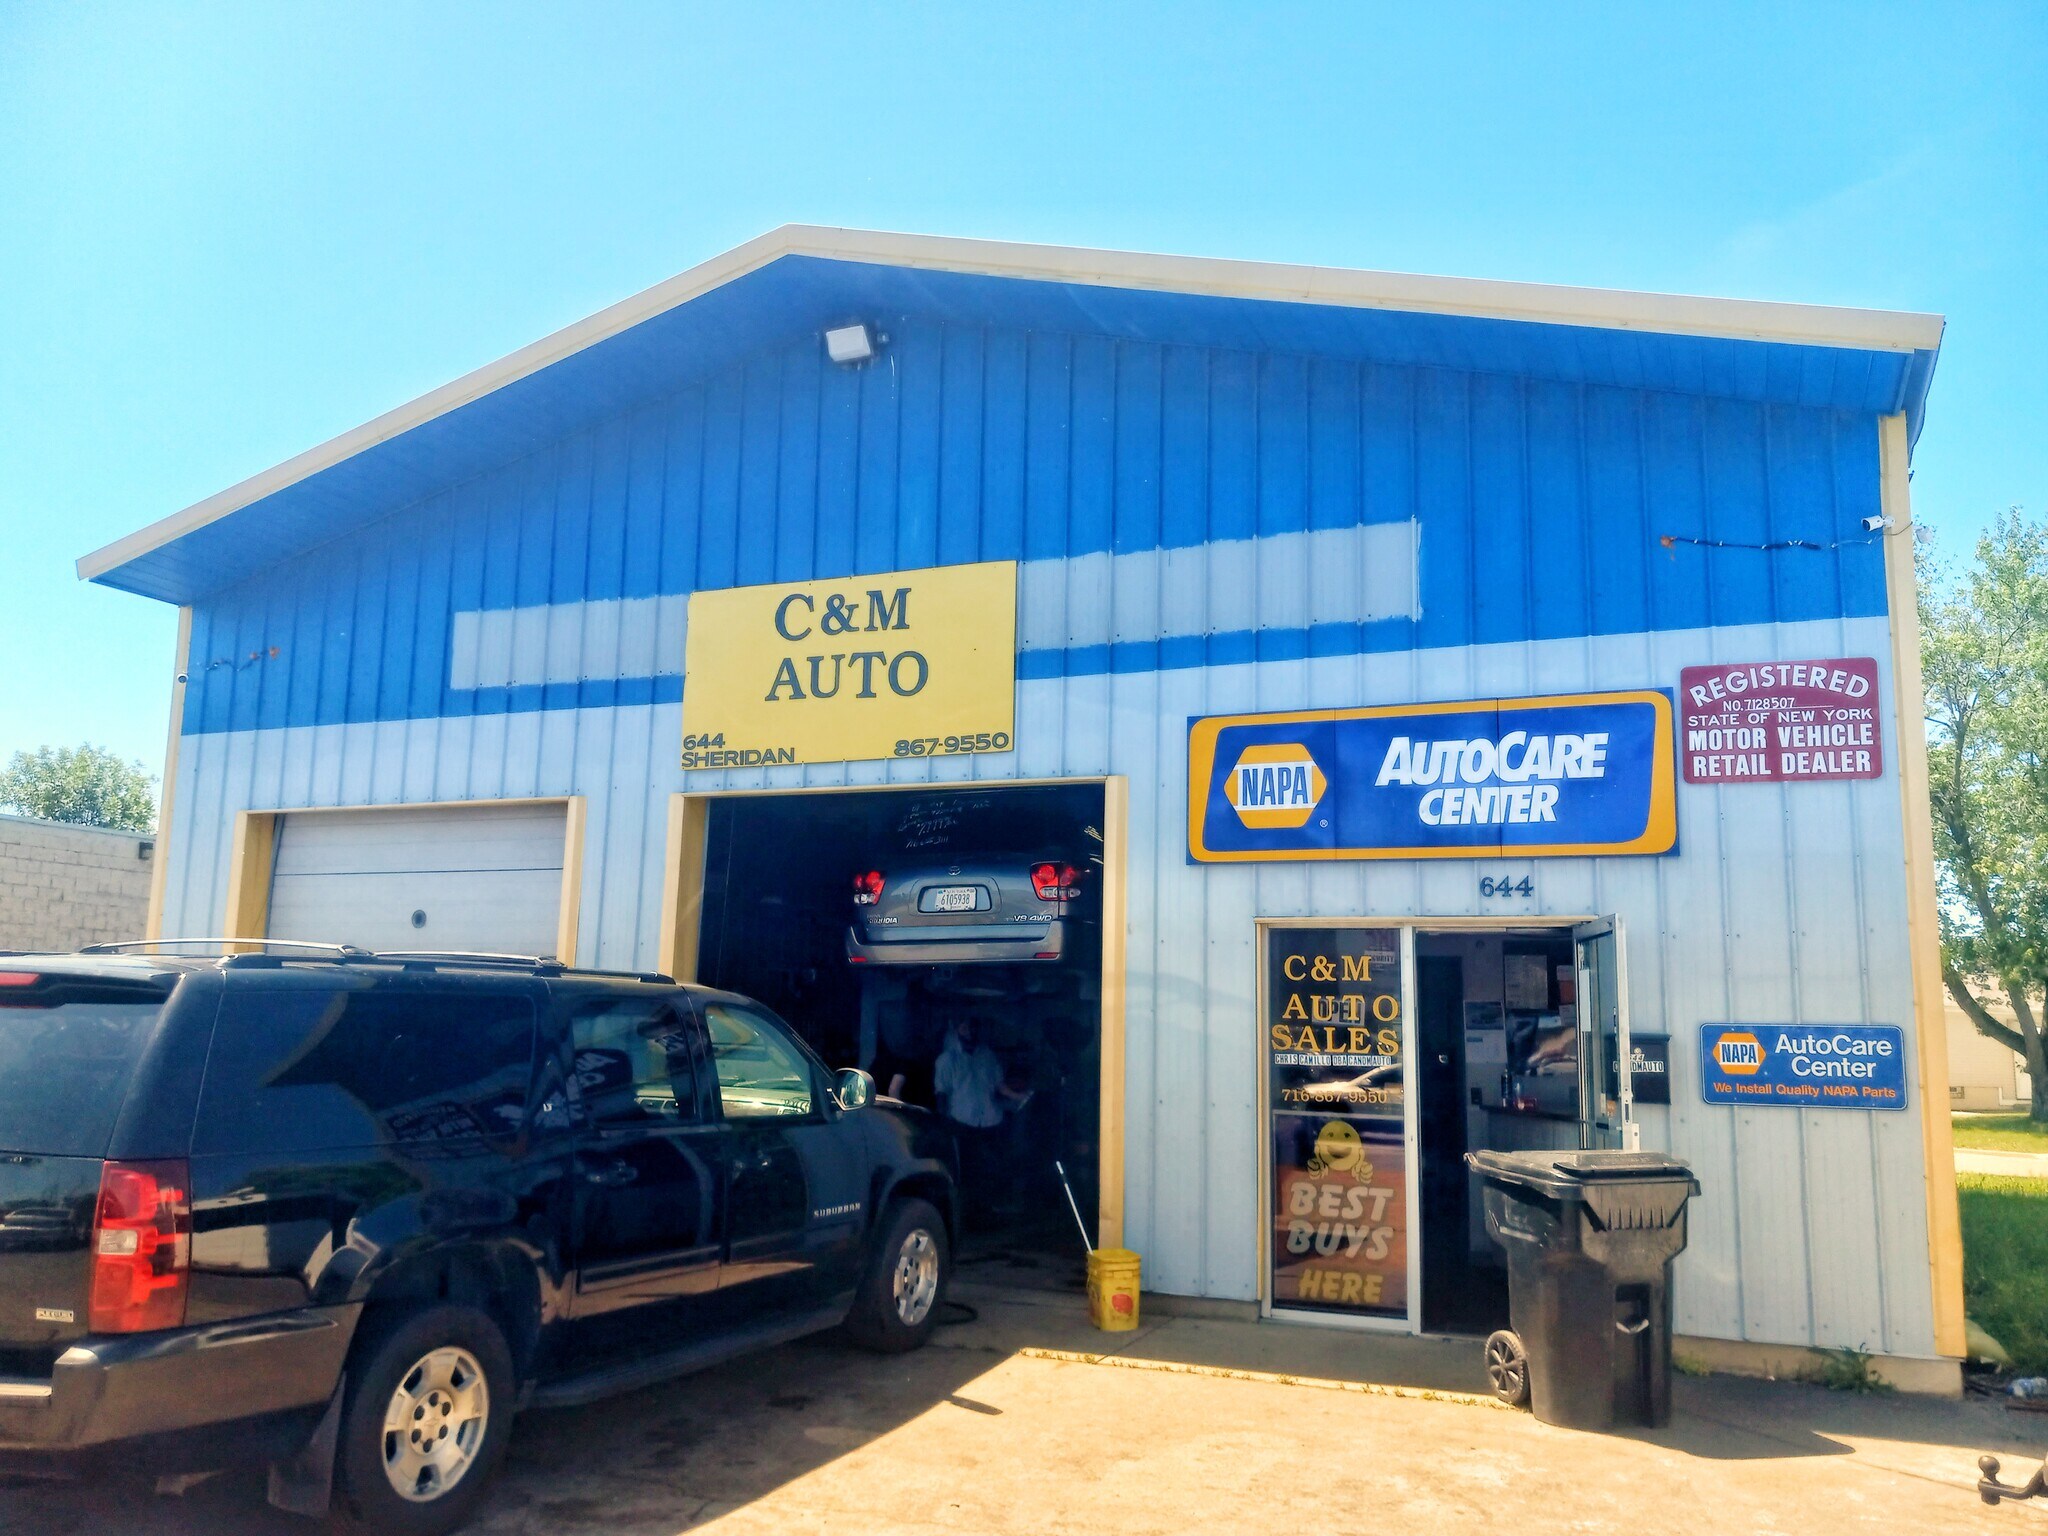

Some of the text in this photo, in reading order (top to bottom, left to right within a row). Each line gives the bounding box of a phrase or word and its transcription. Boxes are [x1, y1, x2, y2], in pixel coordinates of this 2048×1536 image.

[775, 588, 911, 642] C&M
[765, 651, 929, 702] AUTO
[1689, 664, 1869, 708] REGISTERED
[1688, 708, 1873, 727] STATE OF NEW YORK
[683, 733, 726, 750] 644
[894, 732, 1009, 757] 867-9550
[1688, 723, 1874, 752] MOTOR VEHICLE
[681, 748, 795, 768] SHERIDAN
[1375, 731, 1609, 787] AUTOCARE
[1692, 750, 1871, 777] RETAIL DEALER
[1242, 766, 1309, 807] NAPA
[1418, 784, 1560, 827] CENTER
[1480, 875, 1534, 898] 644
[1030, 914, 1052, 922] 4WD
[1283, 954, 1372, 982] C&M
[1282, 994, 1399, 1022] AUTO
[1271, 1025, 1399, 1056] SALES
[1721, 1044, 1757, 1064] NAPA
[1774, 1033, 1893, 1057] AutoCare
[1275, 1054, 1298, 1065] CHRIS
[1299, 1054, 1331, 1065] CAMILLO
[1791, 1055, 1877, 1078] Center
[1281, 1088, 1388, 1104] 716-867-9550
[1713, 1082, 1896, 1099] We Install Quality NAPA Parts
[813, 1202, 861, 1217] SUBURBAN
[1289, 1182, 1394, 1222] BEST
[1286, 1219, 1395, 1261] BUYS
[1298, 1268, 1384, 1304] HERE
